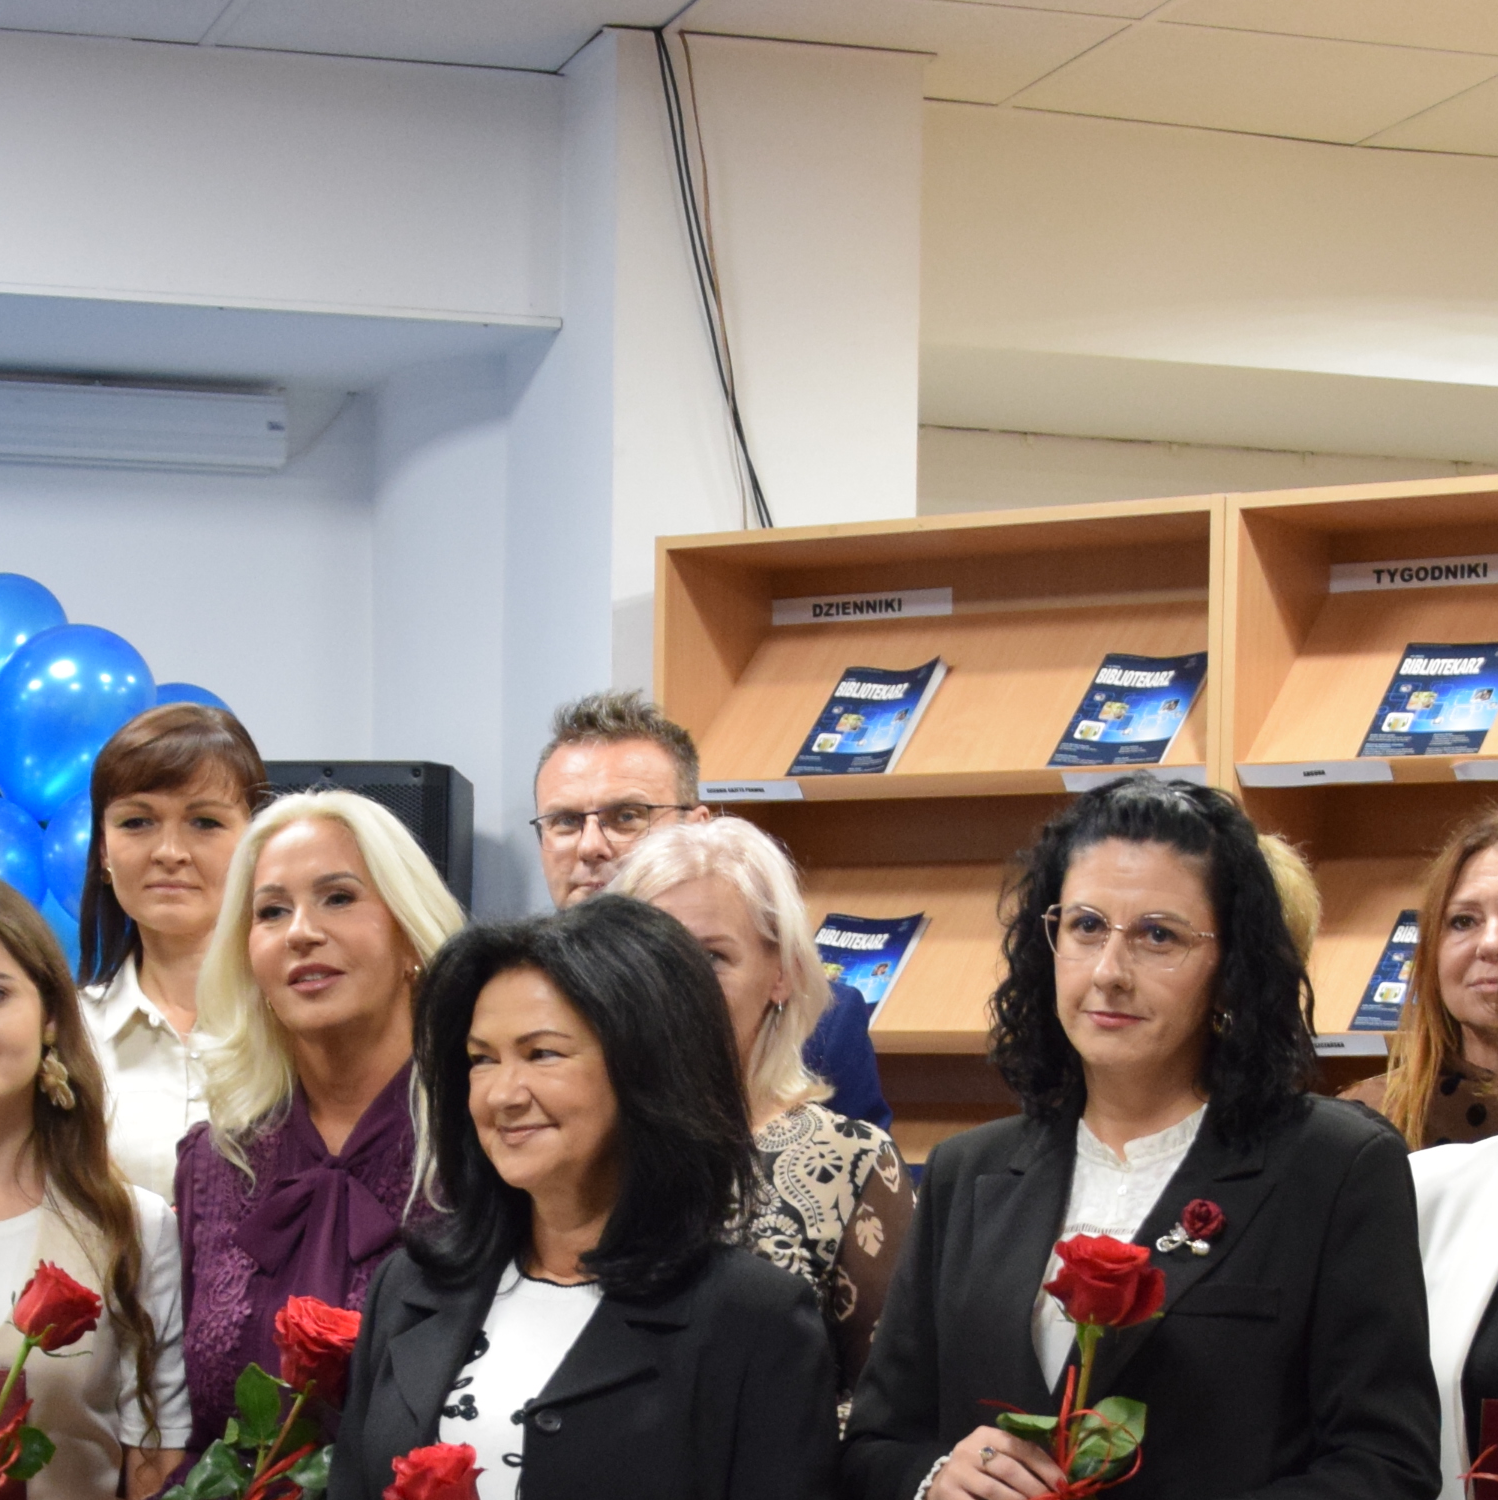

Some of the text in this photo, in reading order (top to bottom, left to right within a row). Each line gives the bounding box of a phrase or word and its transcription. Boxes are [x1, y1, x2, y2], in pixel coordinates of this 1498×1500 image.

[1373, 562, 1488, 584] TYGODNIKI
[812, 598, 902, 618] DZIENNIKI
[1399, 656, 1486, 676] BIBLIOTEKARZ
[1095, 667, 1175, 688] BIBLIOTEKARZ
[834, 681, 909, 700] BIBLIOTEKARZ
[815, 928, 889, 950] BIBLIOTEKARZ
